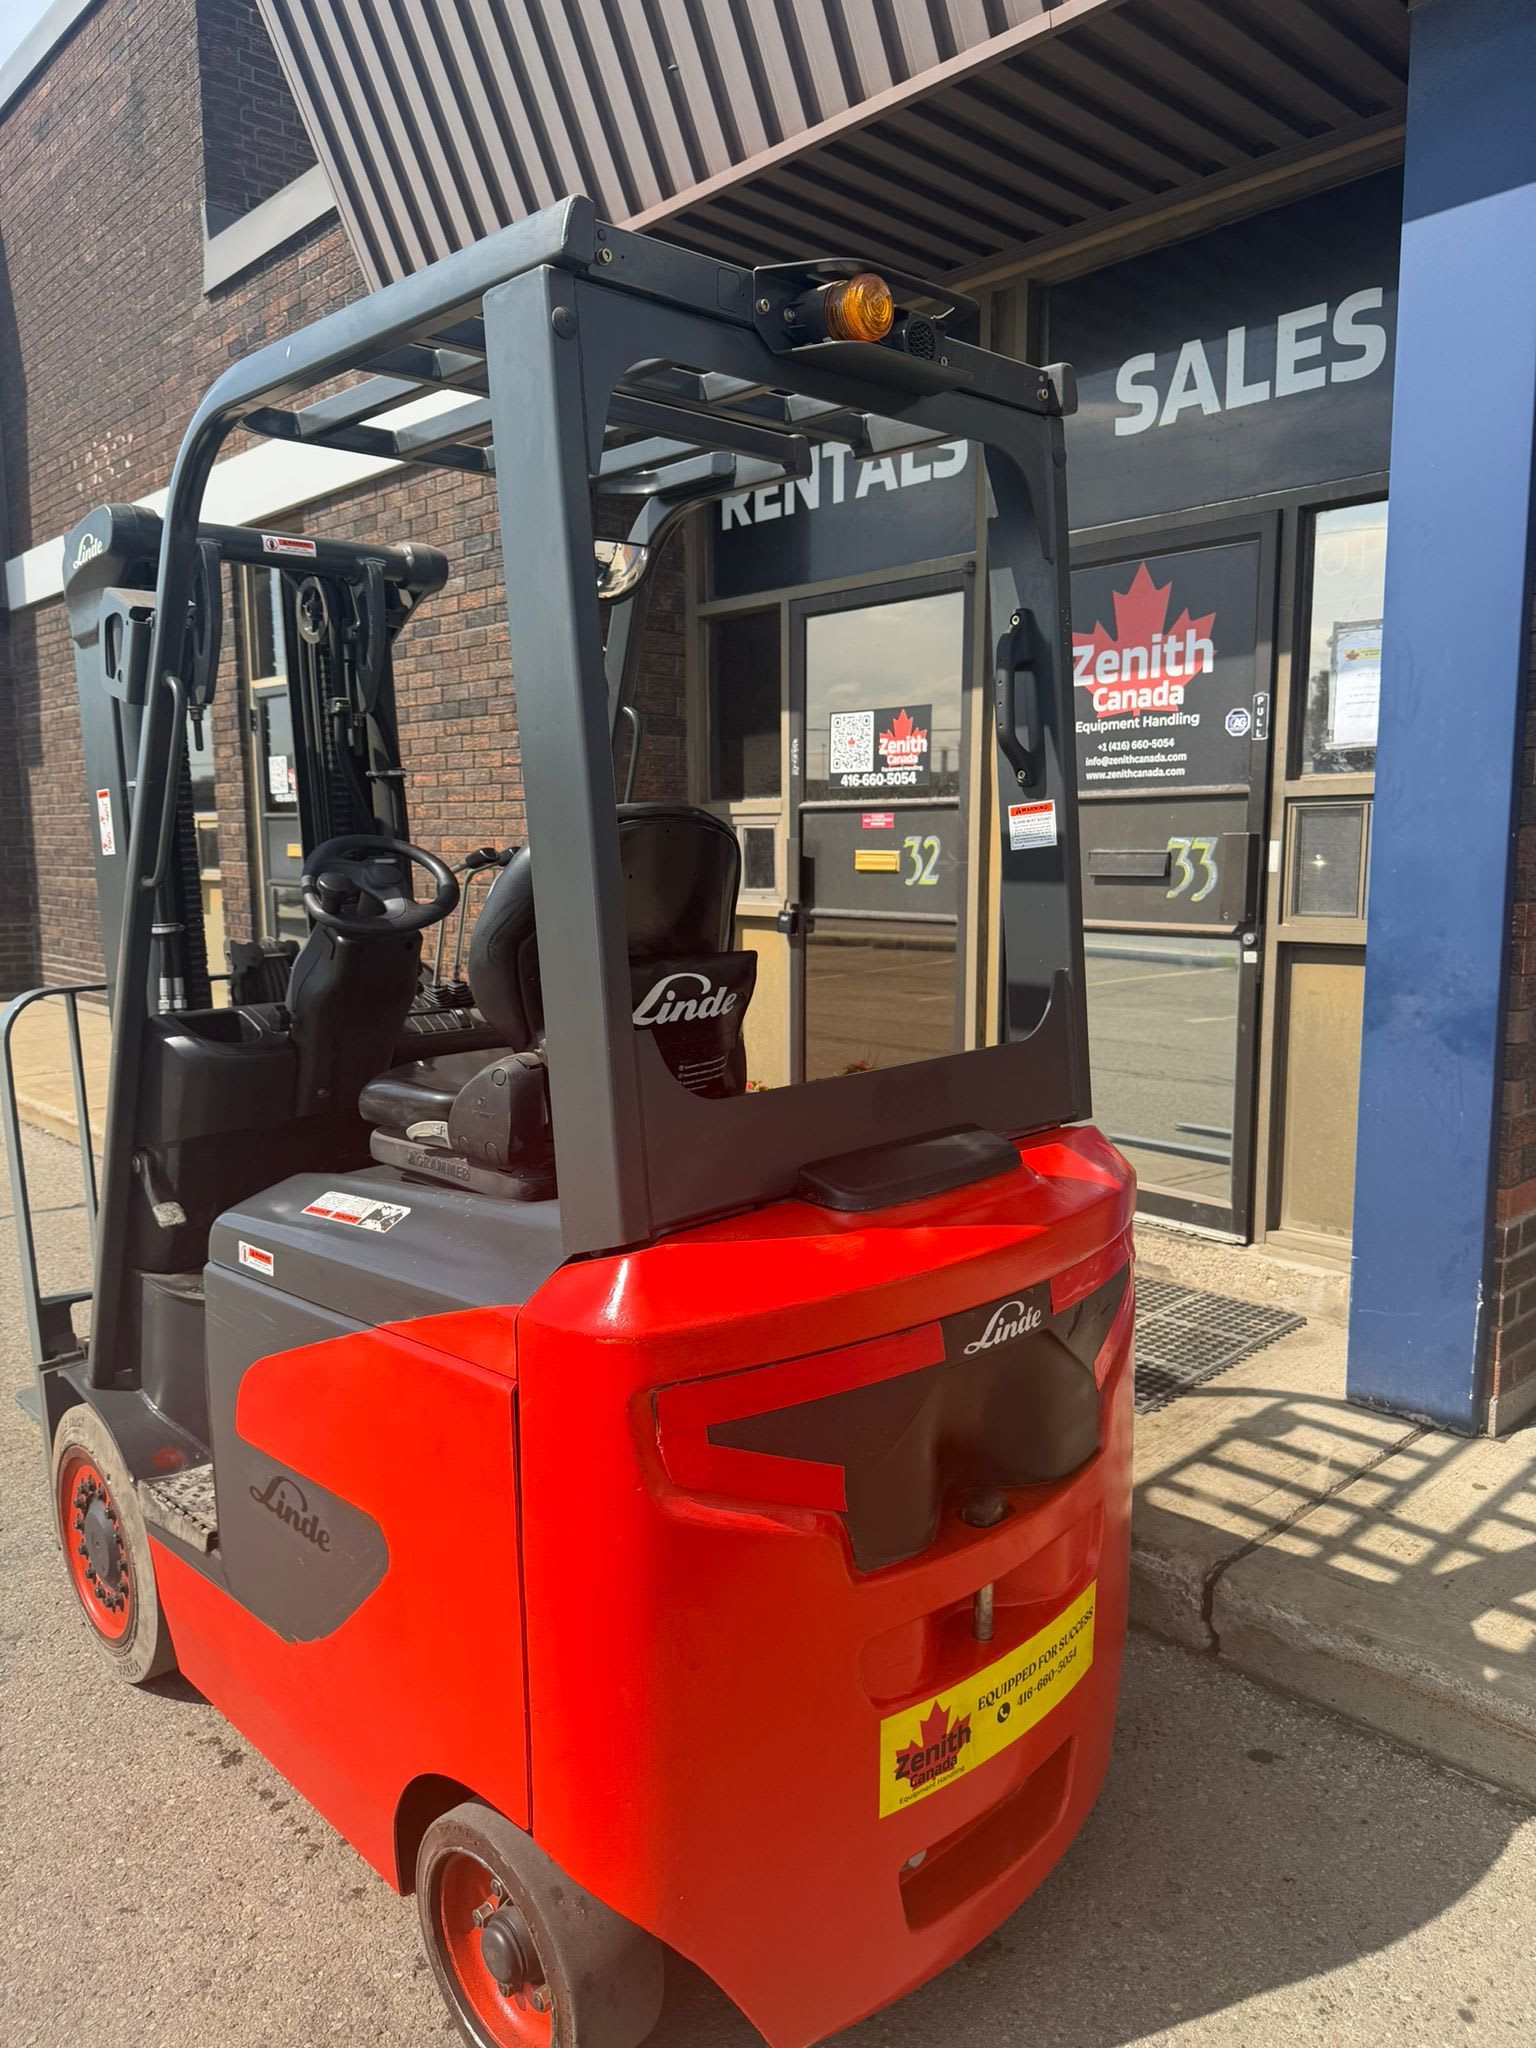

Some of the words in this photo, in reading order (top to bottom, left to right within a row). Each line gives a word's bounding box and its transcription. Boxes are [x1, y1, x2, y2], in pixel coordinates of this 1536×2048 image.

[1114, 287, 1387, 436] SALES
[721, 439, 969, 531] RENTALS
[72, 533, 104, 570] Linde
[1072, 628, 1215, 688] Zenith
[1092, 680, 1185, 712] Canada
[1255, 696, 1265, 738] PULL
[878, 735, 928, 755] Zenith
[1075, 717, 1140, 734] Equipment
[1142, 712, 1200, 727] Handling
[1097, 742, 1108, 752] +1
[1108, 740, 1130, 752] (416)
[1131, 738, 1175, 750] 660-5054
[840, 771, 917, 787] 416-660-5054
[1085, 752, 1187, 767] info@zenithcanada.com
[1085, 767, 1185, 780] www.zenithcanada.com
[903, 835, 941, 886] 32
[1166, 836, 1219, 902] 33
[632, 972, 738, 1026] Linde
[963, 1300, 1042, 1355] Linde
[249, 1475, 331, 1552] Linde
[977, 1662, 1037, 1711] EQUIPPED
[1037, 1644, 1058, 1669] FOR
[1058, 1605, 1094, 1651] SUCCESS
[1017, 1646, 1077, 1706] 416-660-5054
[895, 1724, 972, 1781] Zenith
[909, 1755, 957, 1788] Canada
